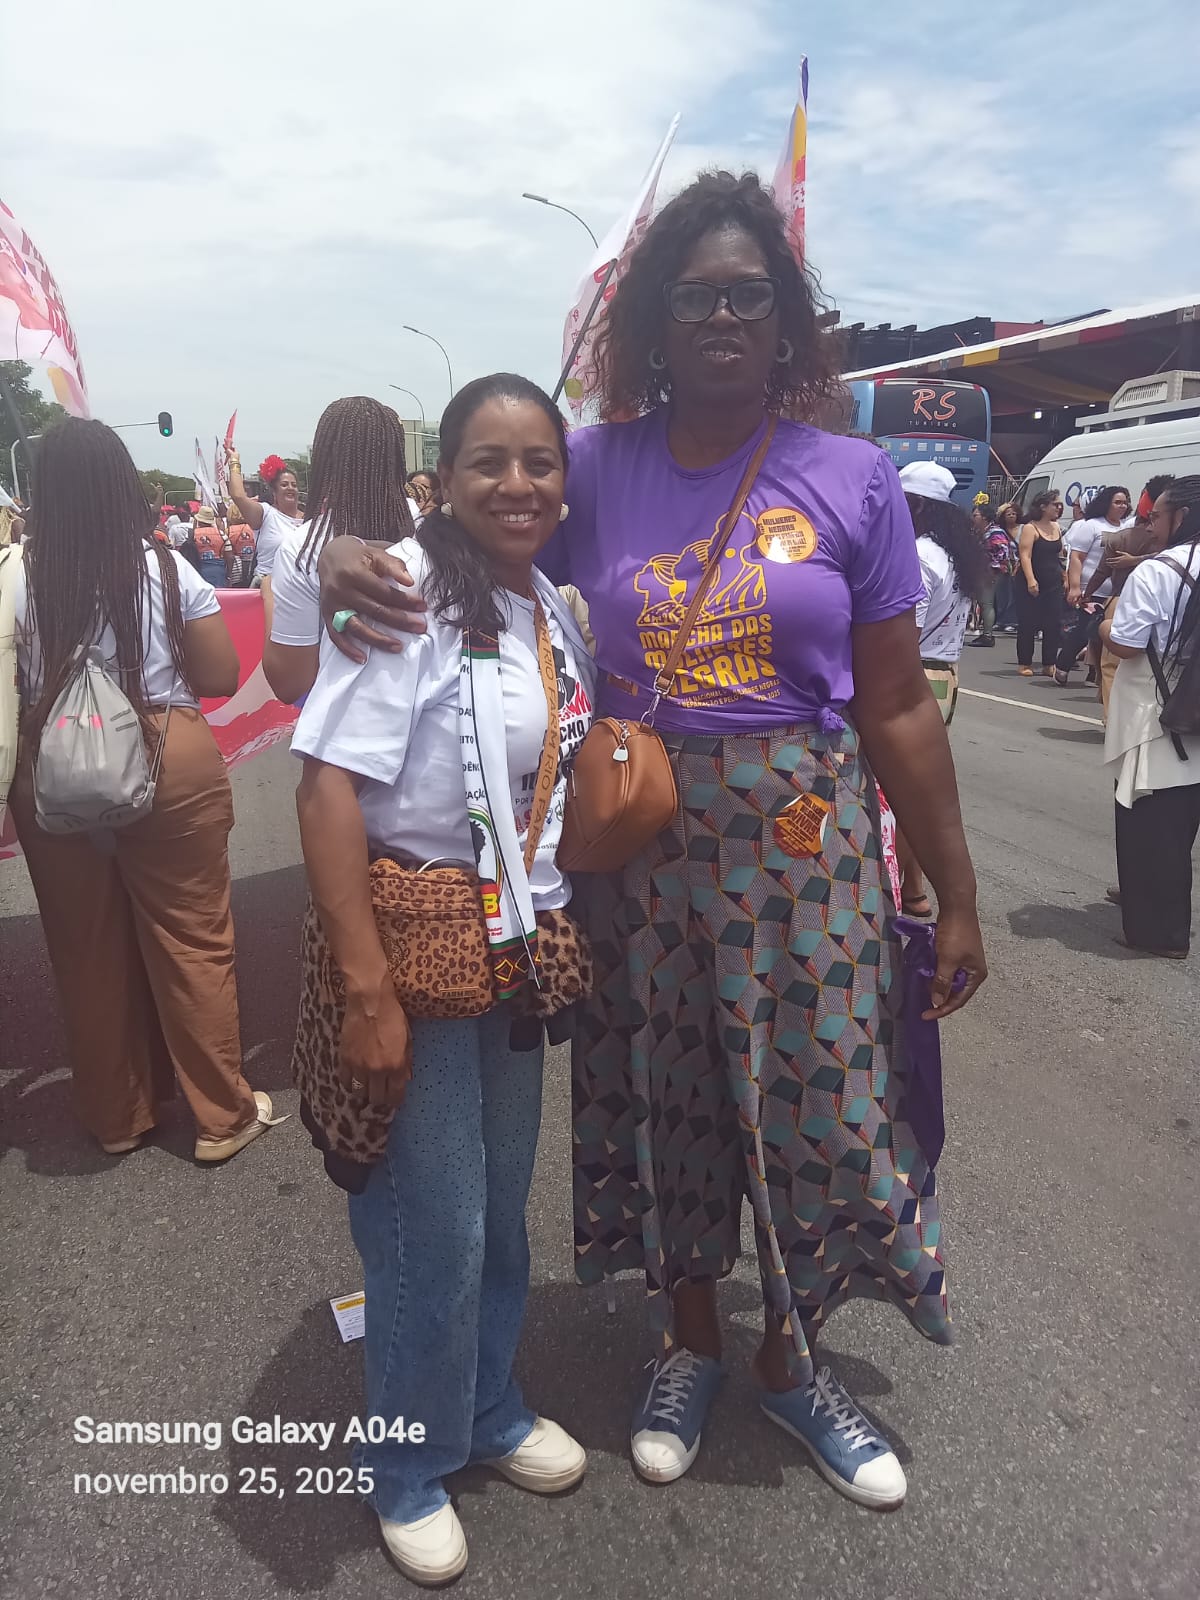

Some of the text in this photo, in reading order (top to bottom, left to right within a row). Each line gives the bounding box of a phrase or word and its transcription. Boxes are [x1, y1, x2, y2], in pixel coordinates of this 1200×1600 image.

[912, 388, 957, 421] RS
[908, 420, 957, 428] TURISMO
[731, 614, 773, 638] DAS
[543, 647, 554, 681] RIO
[644, 635, 773, 669] MLHERES
[547, 685, 558, 749] FARM
[541, 754, 554, 790] RIO
